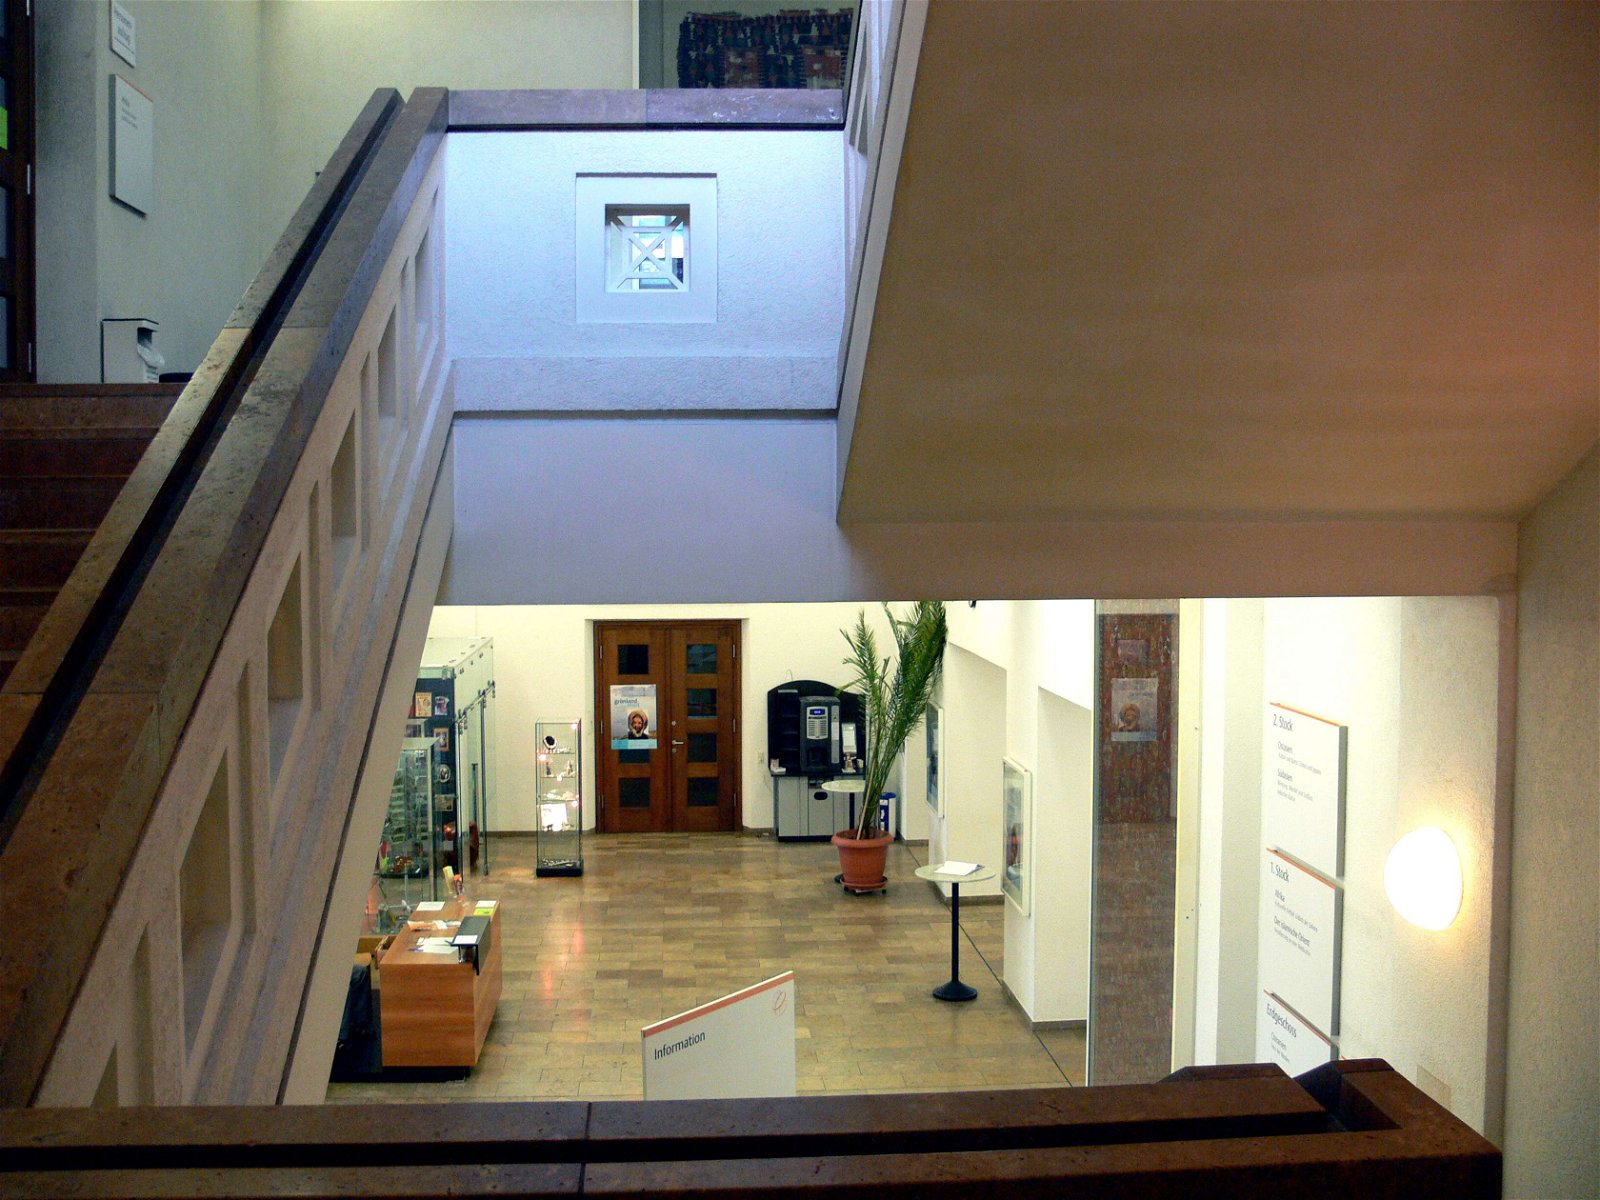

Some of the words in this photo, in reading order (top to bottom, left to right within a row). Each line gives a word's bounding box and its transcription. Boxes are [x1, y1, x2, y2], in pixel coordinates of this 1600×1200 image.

[1279, 716, 1293, 731] Stock
[1275, 864, 1290, 882] Stock
[1266, 1003, 1297, 1038] Erdgeschoss
[654, 1031, 706, 1061] Information
